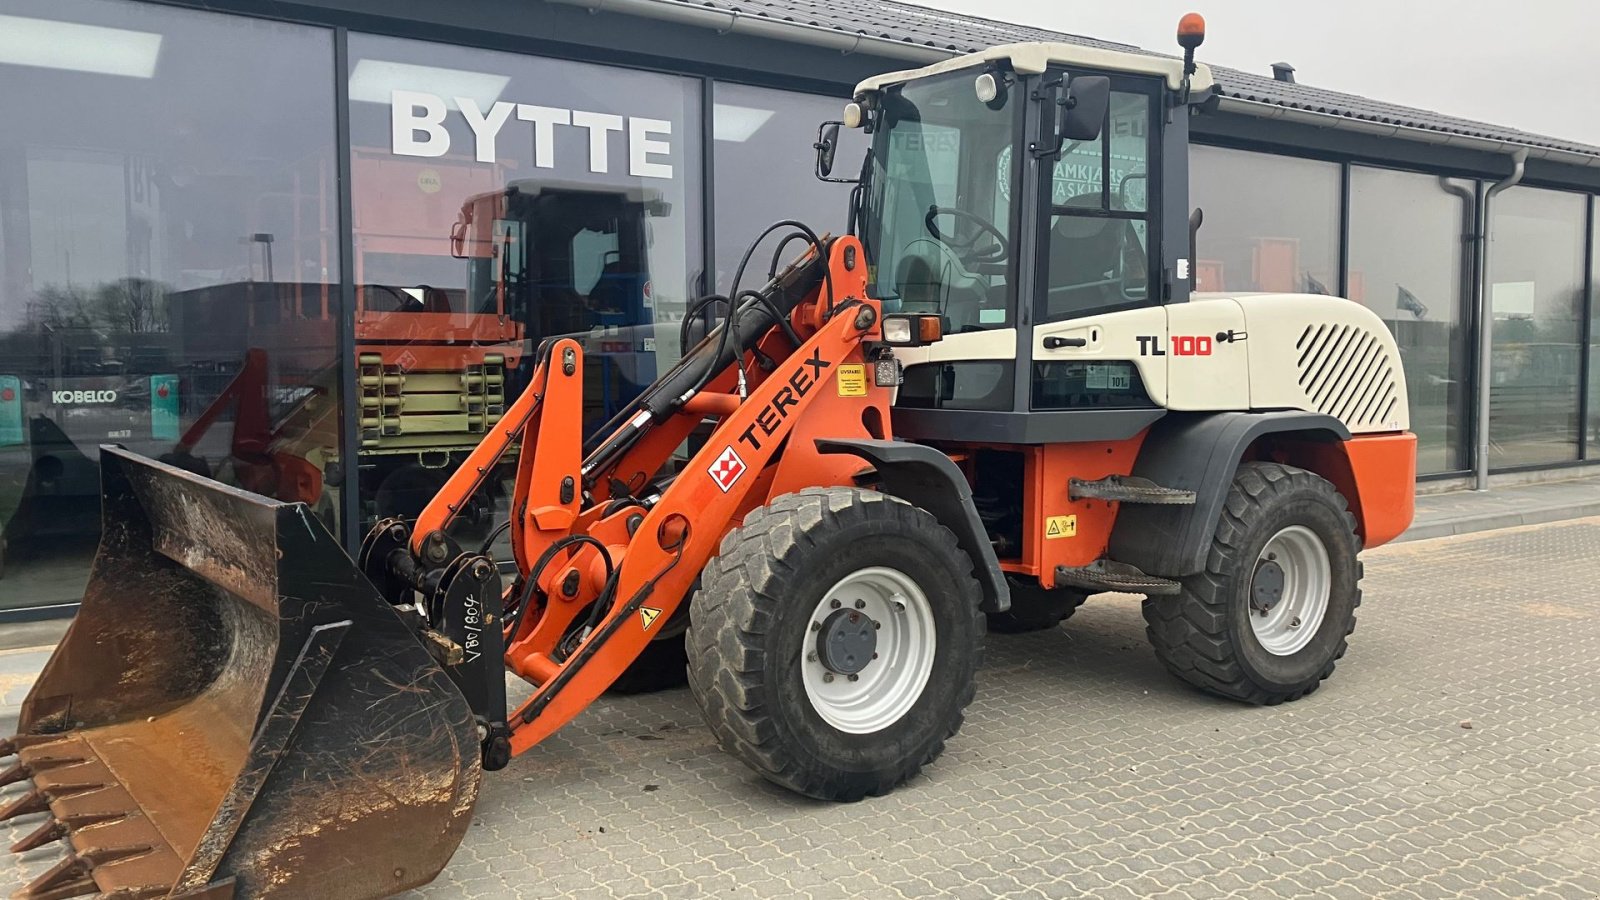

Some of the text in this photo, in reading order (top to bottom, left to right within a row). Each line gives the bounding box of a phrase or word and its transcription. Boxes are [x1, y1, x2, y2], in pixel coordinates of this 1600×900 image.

[392, 89, 674, 180] BYTTE
[1136, 335, 1212, 356] TL 100
[52, 390, 117, 404] KOBELCO
[738, 345, 832, 451] TEREX
